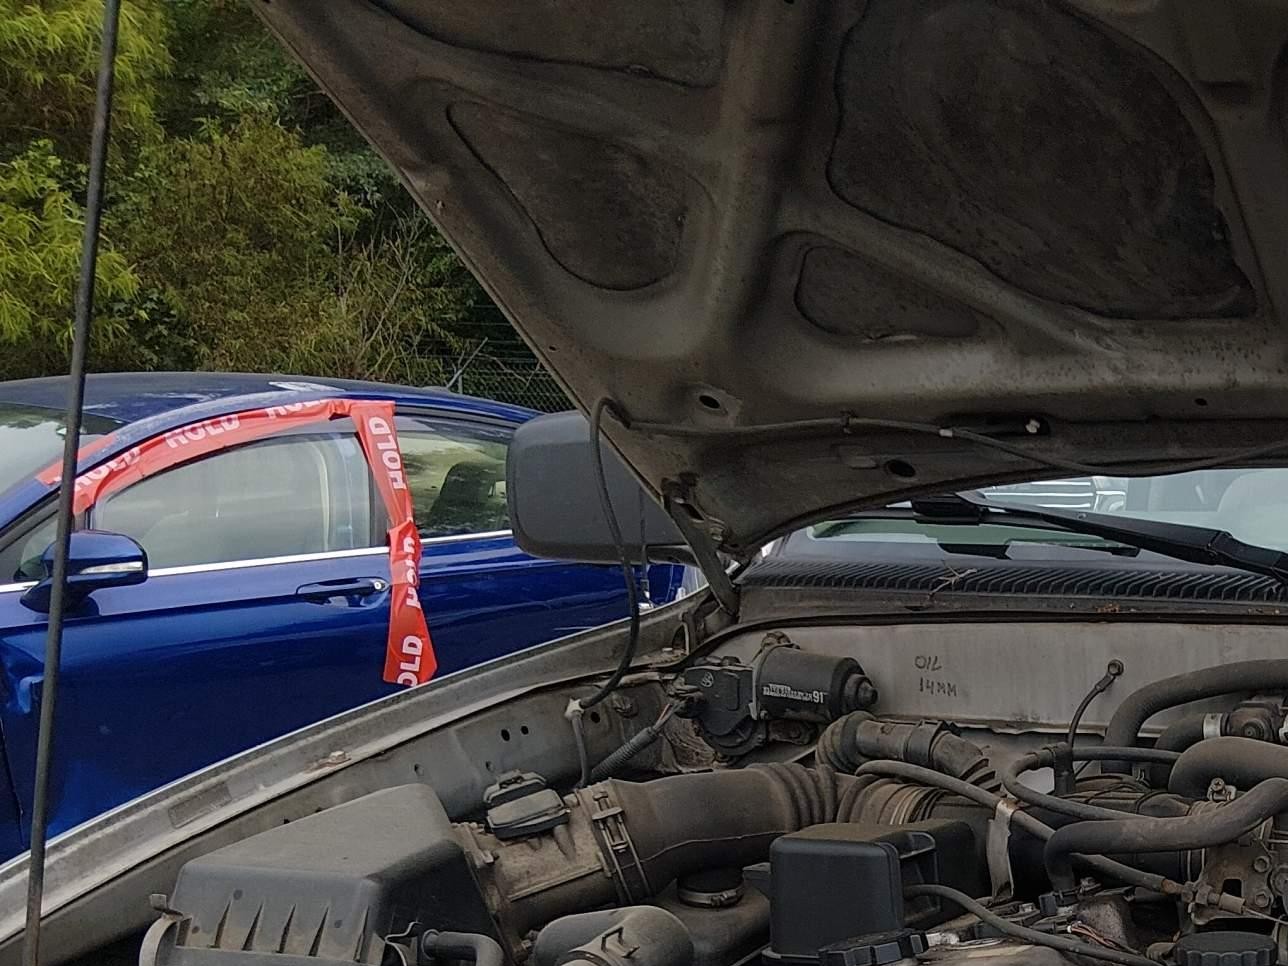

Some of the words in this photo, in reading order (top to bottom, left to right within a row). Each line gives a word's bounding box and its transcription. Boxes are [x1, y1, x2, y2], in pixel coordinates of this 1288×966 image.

[164, 413, 241, 448] HOLD
[368, 416, 407, 490] HOLD
[914, 655, 942, 671] OIL
